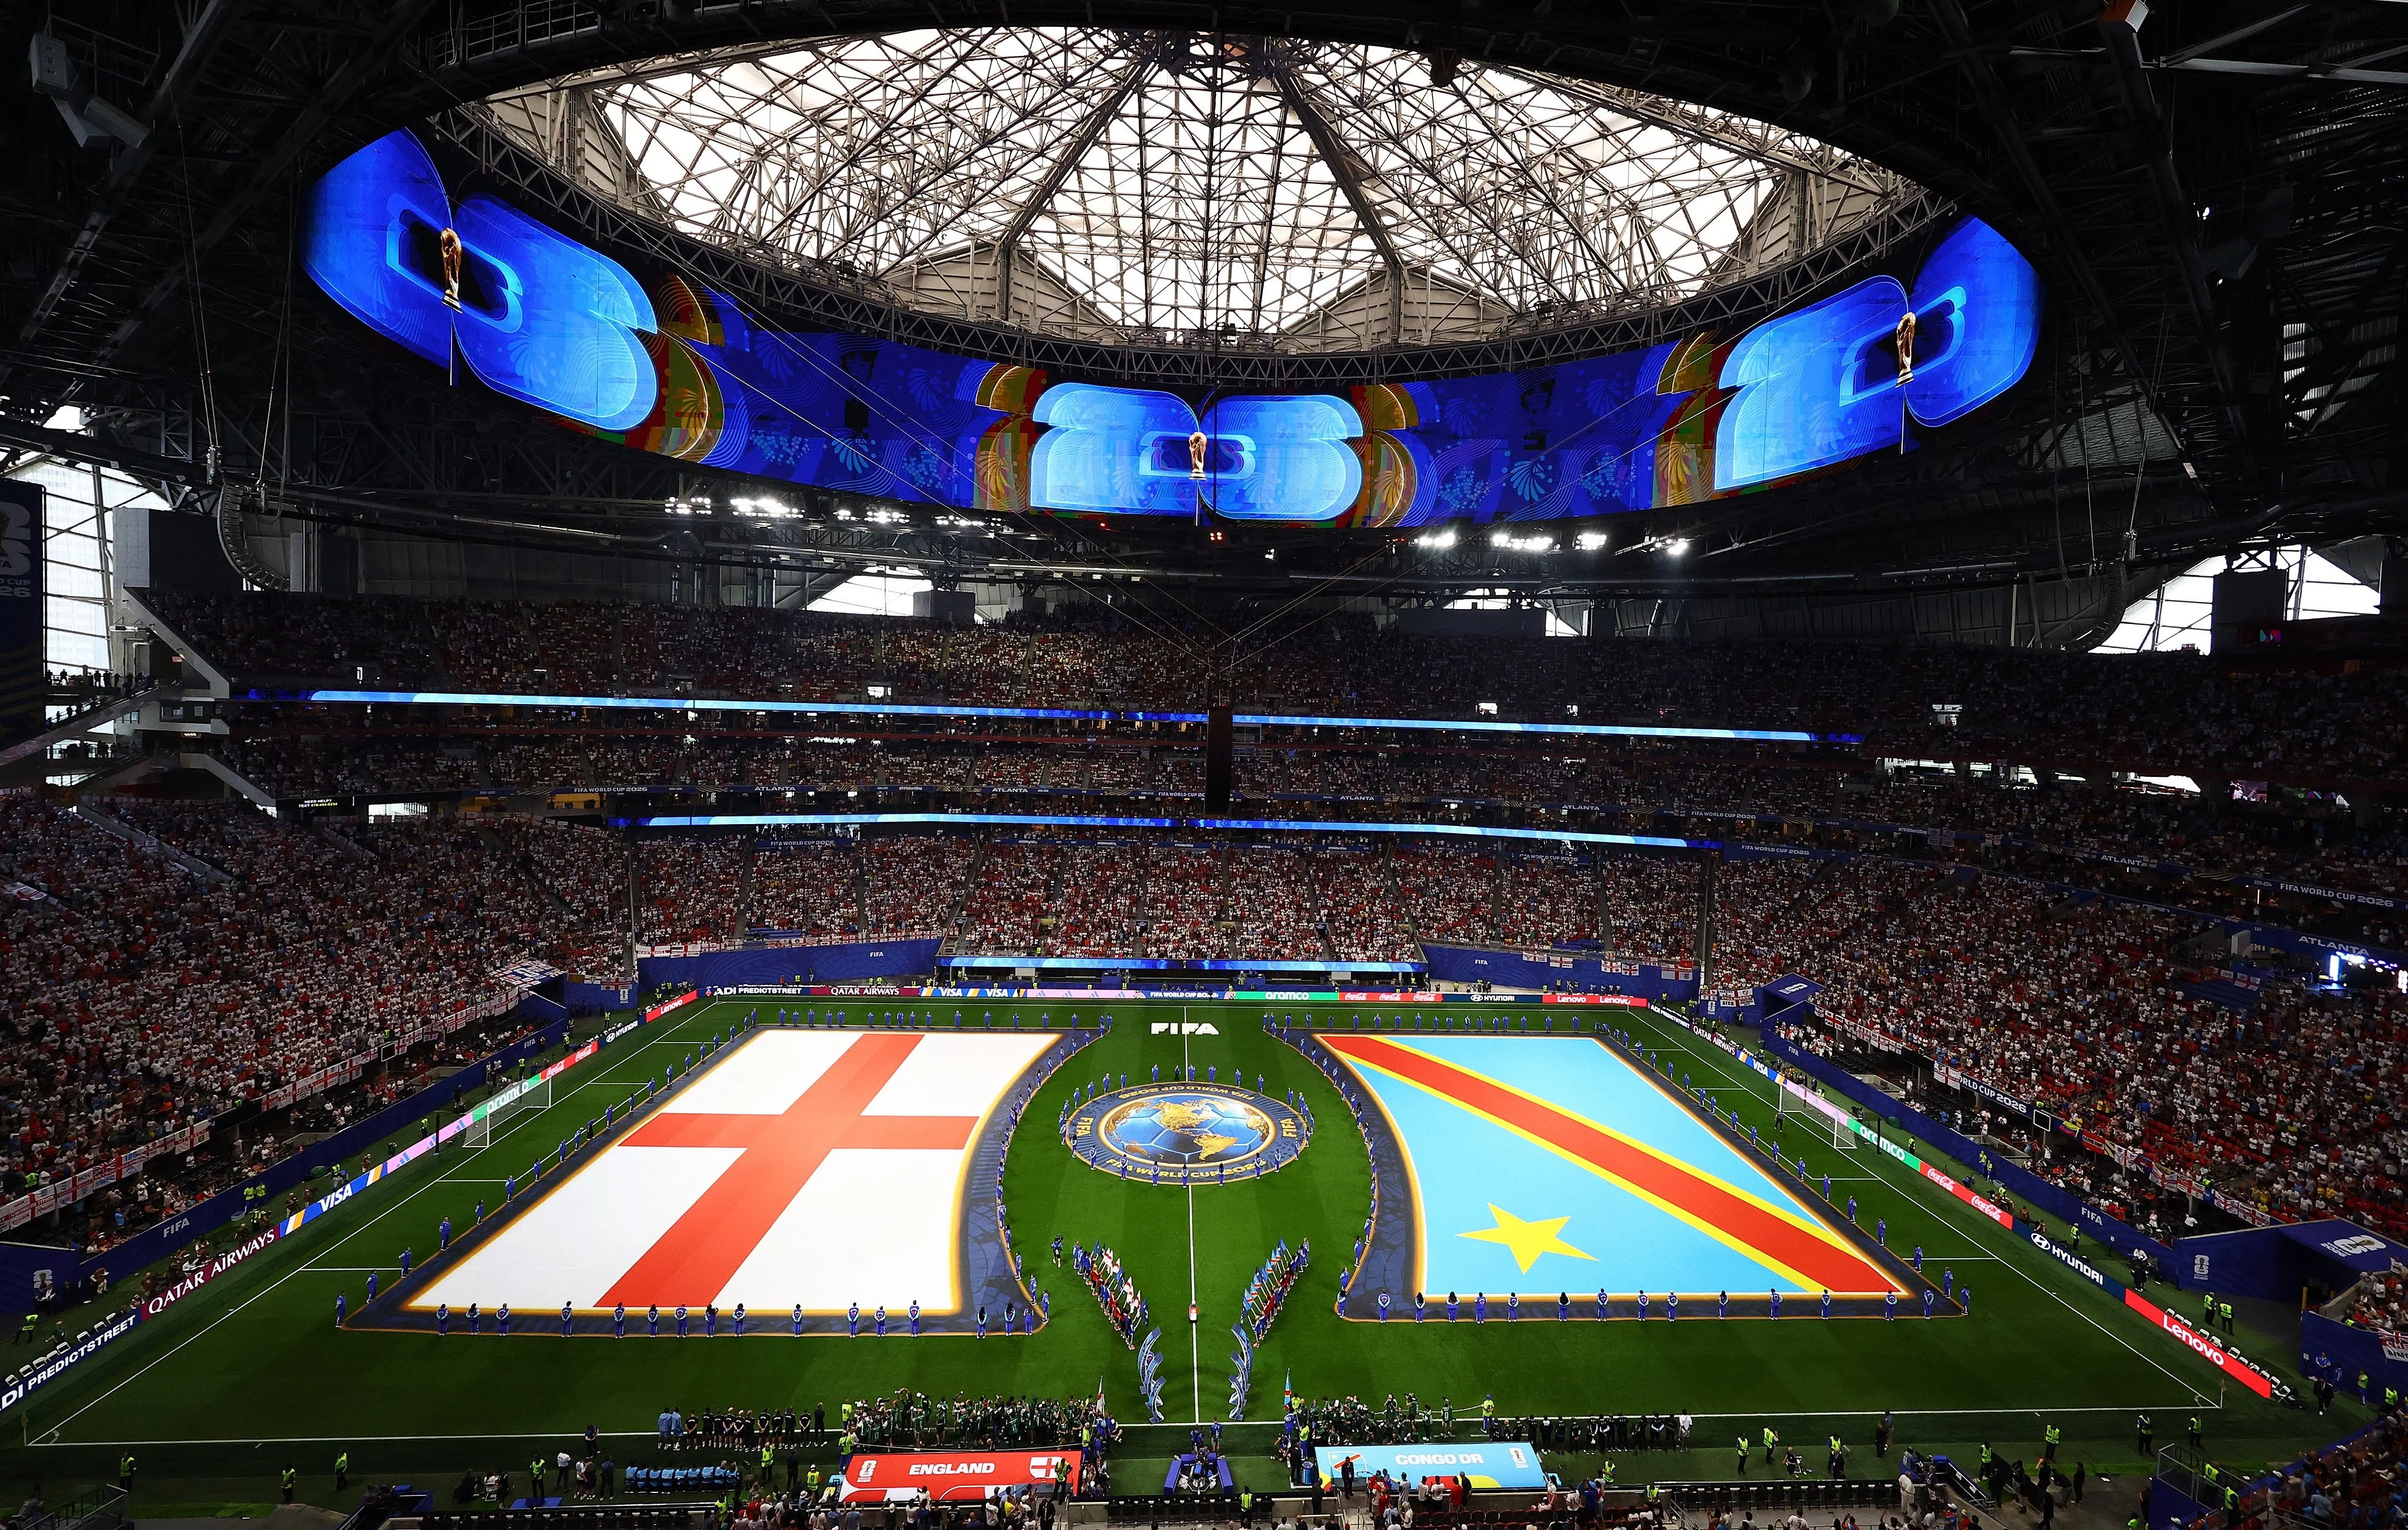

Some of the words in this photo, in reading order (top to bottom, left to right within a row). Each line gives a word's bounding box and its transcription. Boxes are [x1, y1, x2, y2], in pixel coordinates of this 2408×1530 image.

[2100, 855, 2145, 867] ATLANT
[2280, 883, 2299, 893] FIFA
[2300, 886, 2335, 898] WORLD
[2336, 892, 2355, 901] CUP
[2357, 896, 2394, 908] 2026
[2299, 936, 2370, 956] ATLANTA
[714, 987, 736, 995] ADI
[738, 987, 802, 995] PREDICTSTREET
[831, 987, 860, 996] QATAR
[863, 987, 899, 996] AIRWAYS
[940, 988, 963, 997] VISA
[986, 988, 1008, 997] VISA
[1265, 991, 1309, 1000] aramco
[1599, 996, 1630, 1005] Lenovo
[661, 999, 683, 1015] Lenovo
[1651, 1004, 1662, 1016] ADI
[1663, 1010, 1690, 1030] PREDICTSTREET
[615, 1019, 638, 1038] HYUNDAI
[1151, 1022, 1220, 1034] FIFA
[524, 1038, 535, 1049] FIFA
[1693, 1025, 1712, 1041] QATAR
[1712, 1035, 1736, 1055] AIRWAYS
[1788, 1046, 1799, 1057] FIFA
[1752, 1058, 1768, 1076] VISA
[486, 1081, 529, 1114] aramco
[1118, 1087, 1160, 1099] 2026
[1186, 1086, 1228, 1094] WORLD
[1231, 1090, 1255, 1101] FIFA
[1959, 1076, 1978, 1090] RLD
[1979, 1085, 1995, 1098] CUP
[1997, 1093, 2027, 1113] 2026
[1076, 1116, 1094, 1137] FIFA
[1279, 1117, 1297, 1138] FIFA
[1859, 1125, 1905, 1161] aramco
[1105, 1158, 1134, 1172] FIA
[1137, 1168, 1185, 1178] WRLD
[318, 1184, 352, 1212] VISA
[2081, 1206, 2103, 1227] FIFA
[162, 1216, 189, 1238] FIFA
[148, 1271, 205, 1314] QATAR
[210, 1228, 275, 1278] AIRWAYS
[2051, 1244, 2103, 1286] HYUNDAI
[2163, 1313, 2225, 1366] Lenovo
[0, 1384, 24, 1412] DI
[27, 1314, 136, 1391] PREDICTSTREET
[1395, 1454, 1457, 1466] CONGO
[1458, 1453, 1484, 1464] DR
[908, 1463, 996, 1476] ENGLAND
